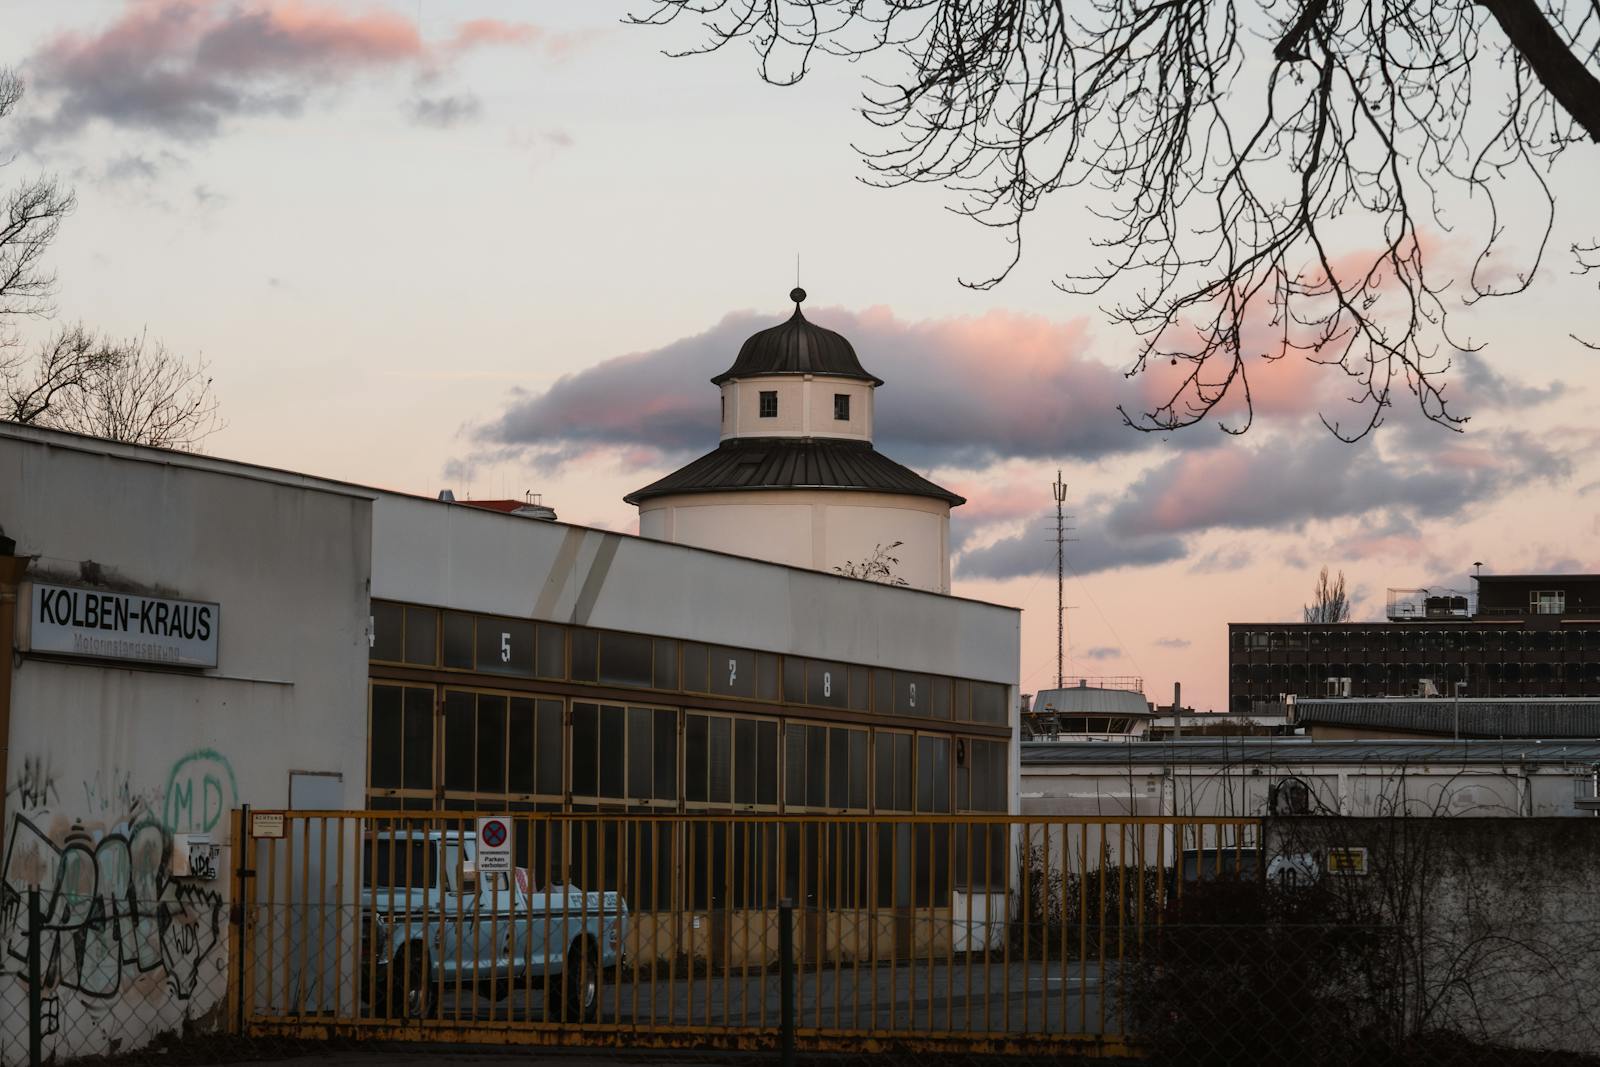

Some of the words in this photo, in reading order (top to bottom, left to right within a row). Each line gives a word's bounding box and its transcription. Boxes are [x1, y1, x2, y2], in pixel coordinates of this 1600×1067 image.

[40, 588, 211, 641] KOLBEN-KRAUS
[501, 632, 511, 662] 5
[728, 659, 737, 686] 7
[823, 671, 831, 698] 8
[909, 683, 916, 708] 9
